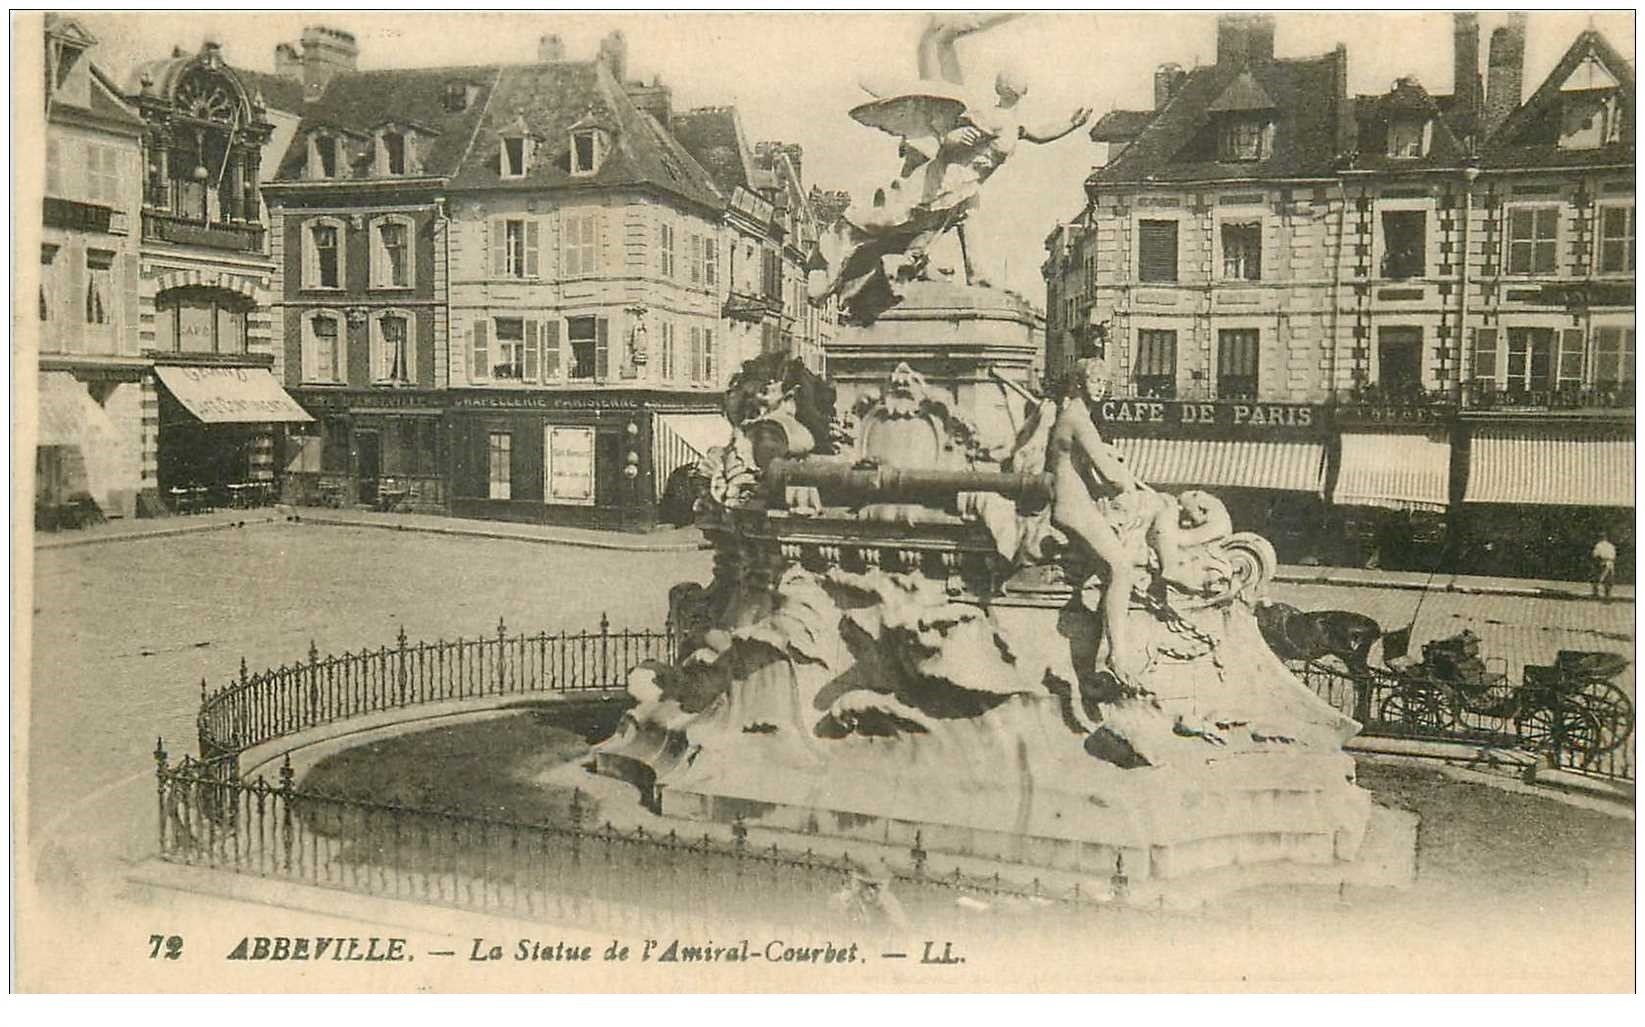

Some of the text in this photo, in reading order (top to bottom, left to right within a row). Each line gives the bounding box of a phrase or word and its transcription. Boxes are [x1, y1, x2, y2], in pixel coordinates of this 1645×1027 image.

[454, 398, 638, 408] CHAPELLERIE PARISIENNE
[1102, 401, 1164, 422] CAFE
[1180, 404, 1216, 424] DE
[1233, 405, 1313, 426] PARIS
